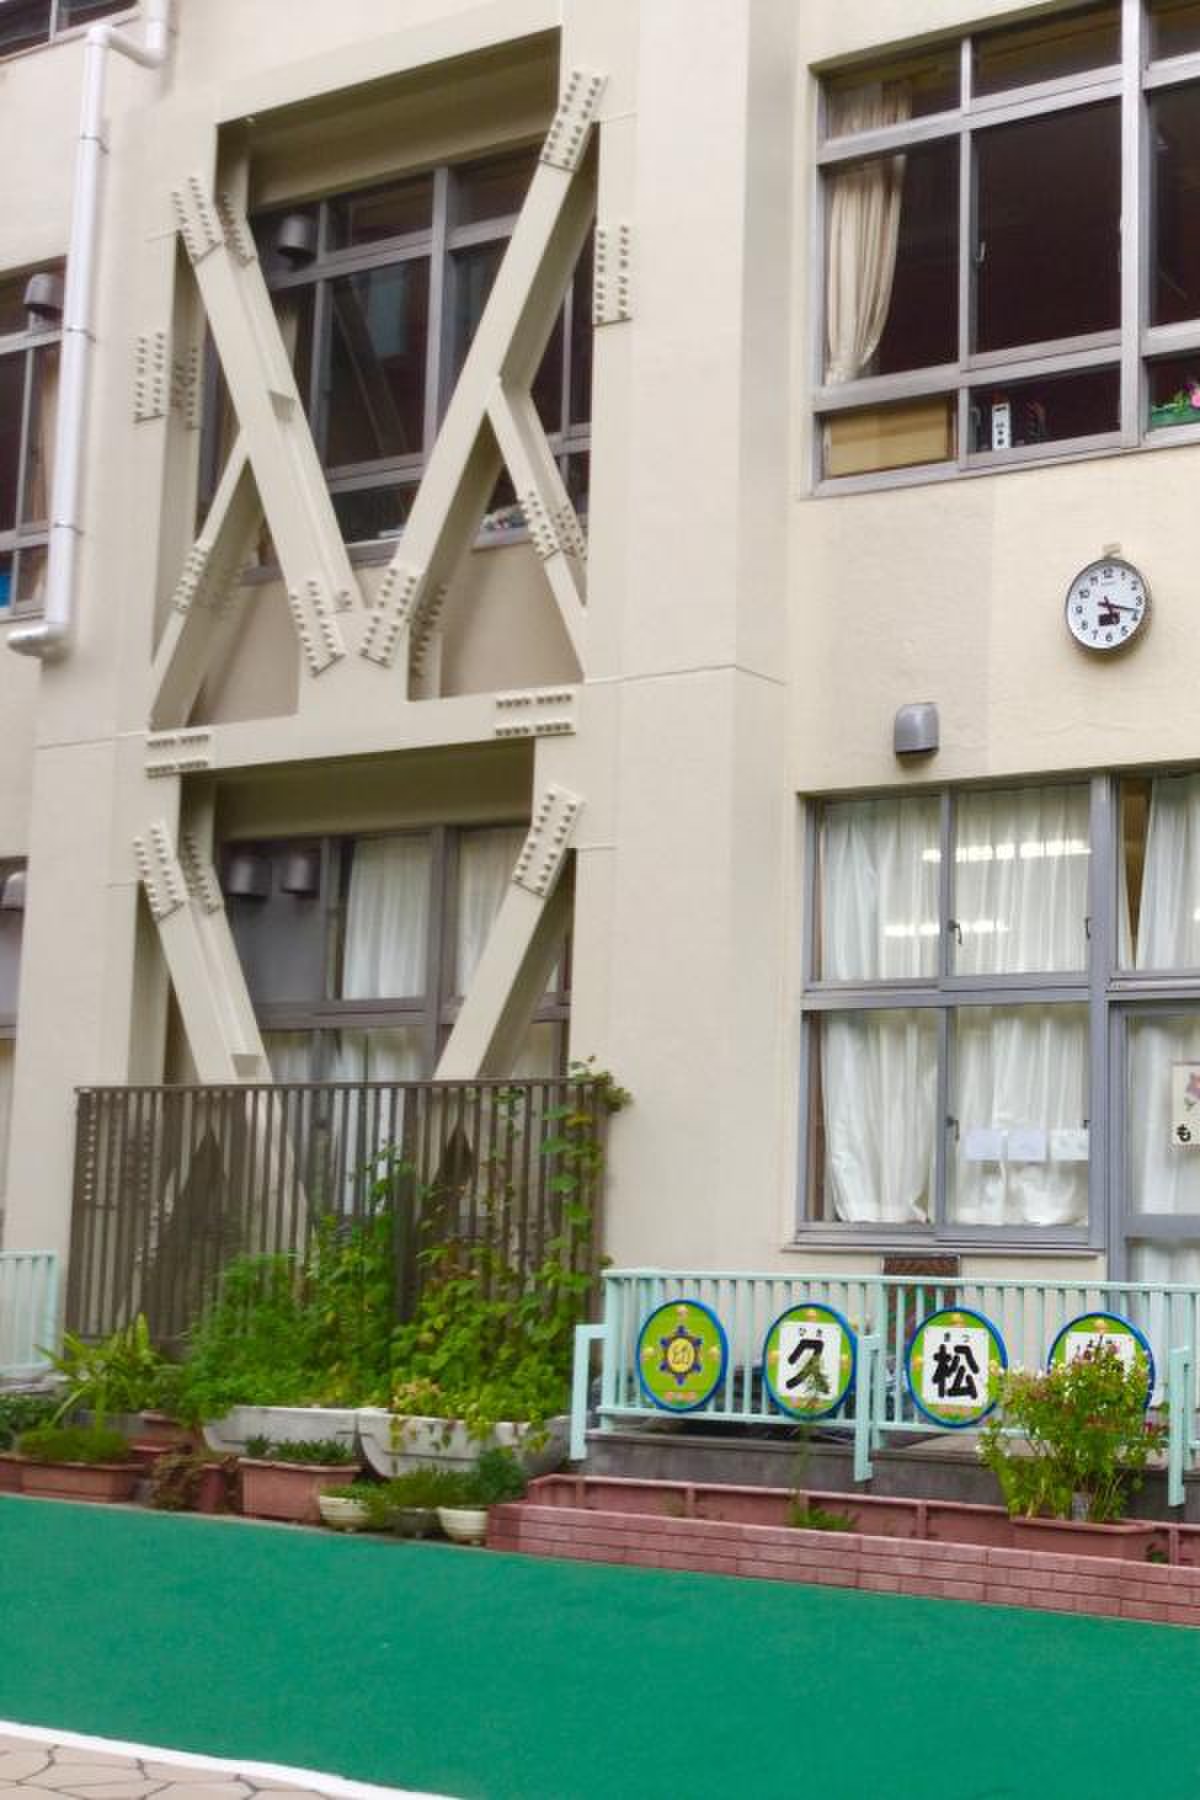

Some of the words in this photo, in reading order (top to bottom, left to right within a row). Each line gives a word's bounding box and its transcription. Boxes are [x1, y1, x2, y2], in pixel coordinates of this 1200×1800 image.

[1103, 567, 1114, 578] 12
[1079, 589, 1090, 599] 10
[786, 1339, 830, 1394] 久
[932, 1343, 979, 1399] 松
